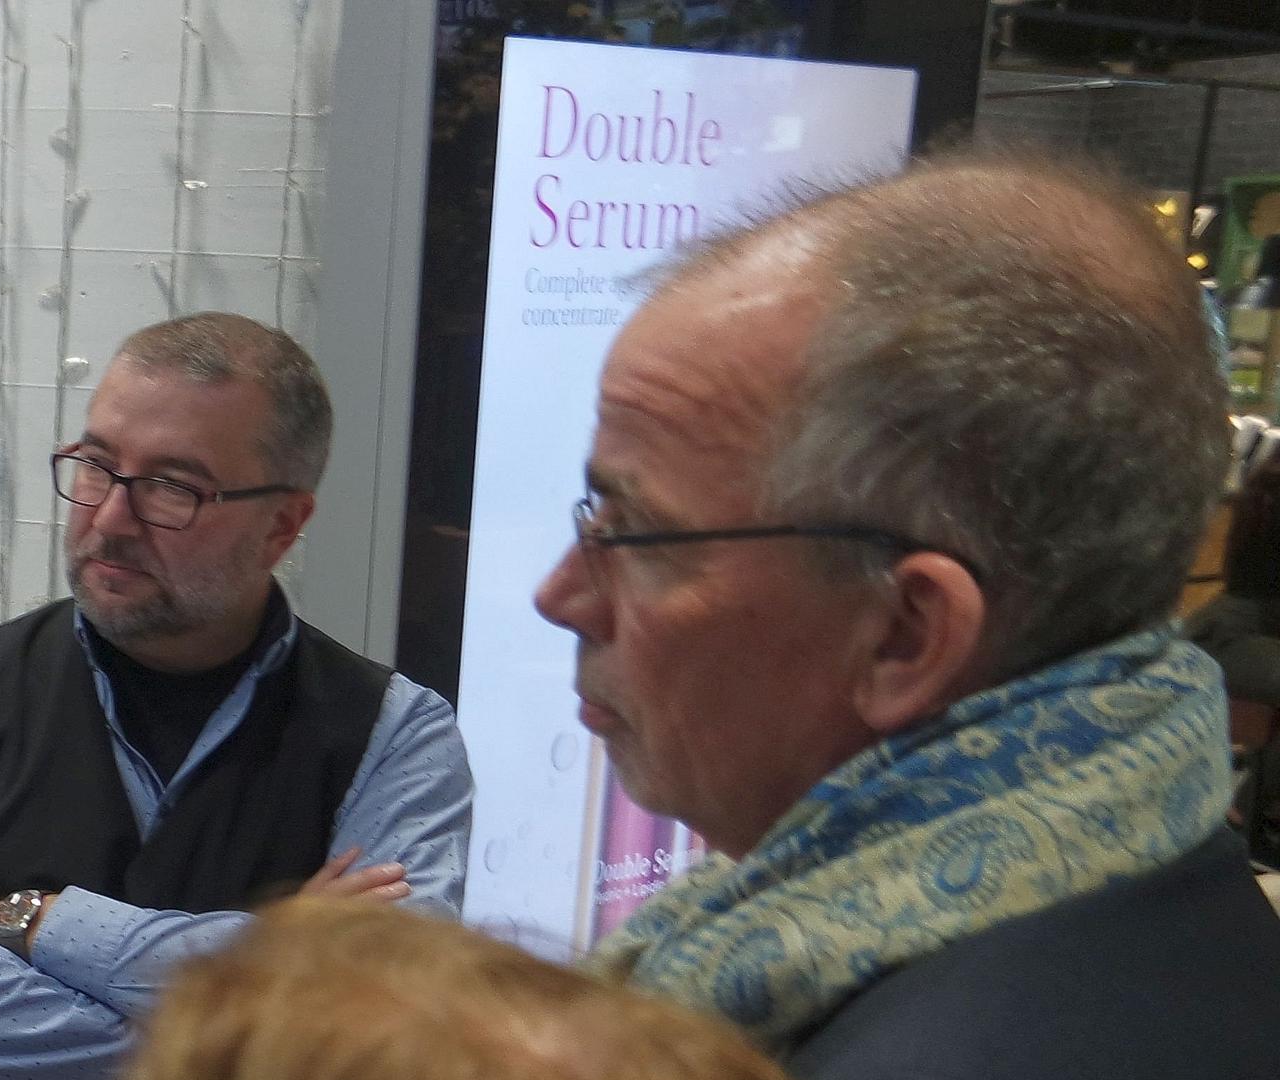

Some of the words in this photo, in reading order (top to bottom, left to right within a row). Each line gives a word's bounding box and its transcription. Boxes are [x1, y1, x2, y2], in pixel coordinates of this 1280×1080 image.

[537, 85, 721, 166] Double
[530, 174, 701, 248] Serum
[524, 266, 604, 301] Complete
